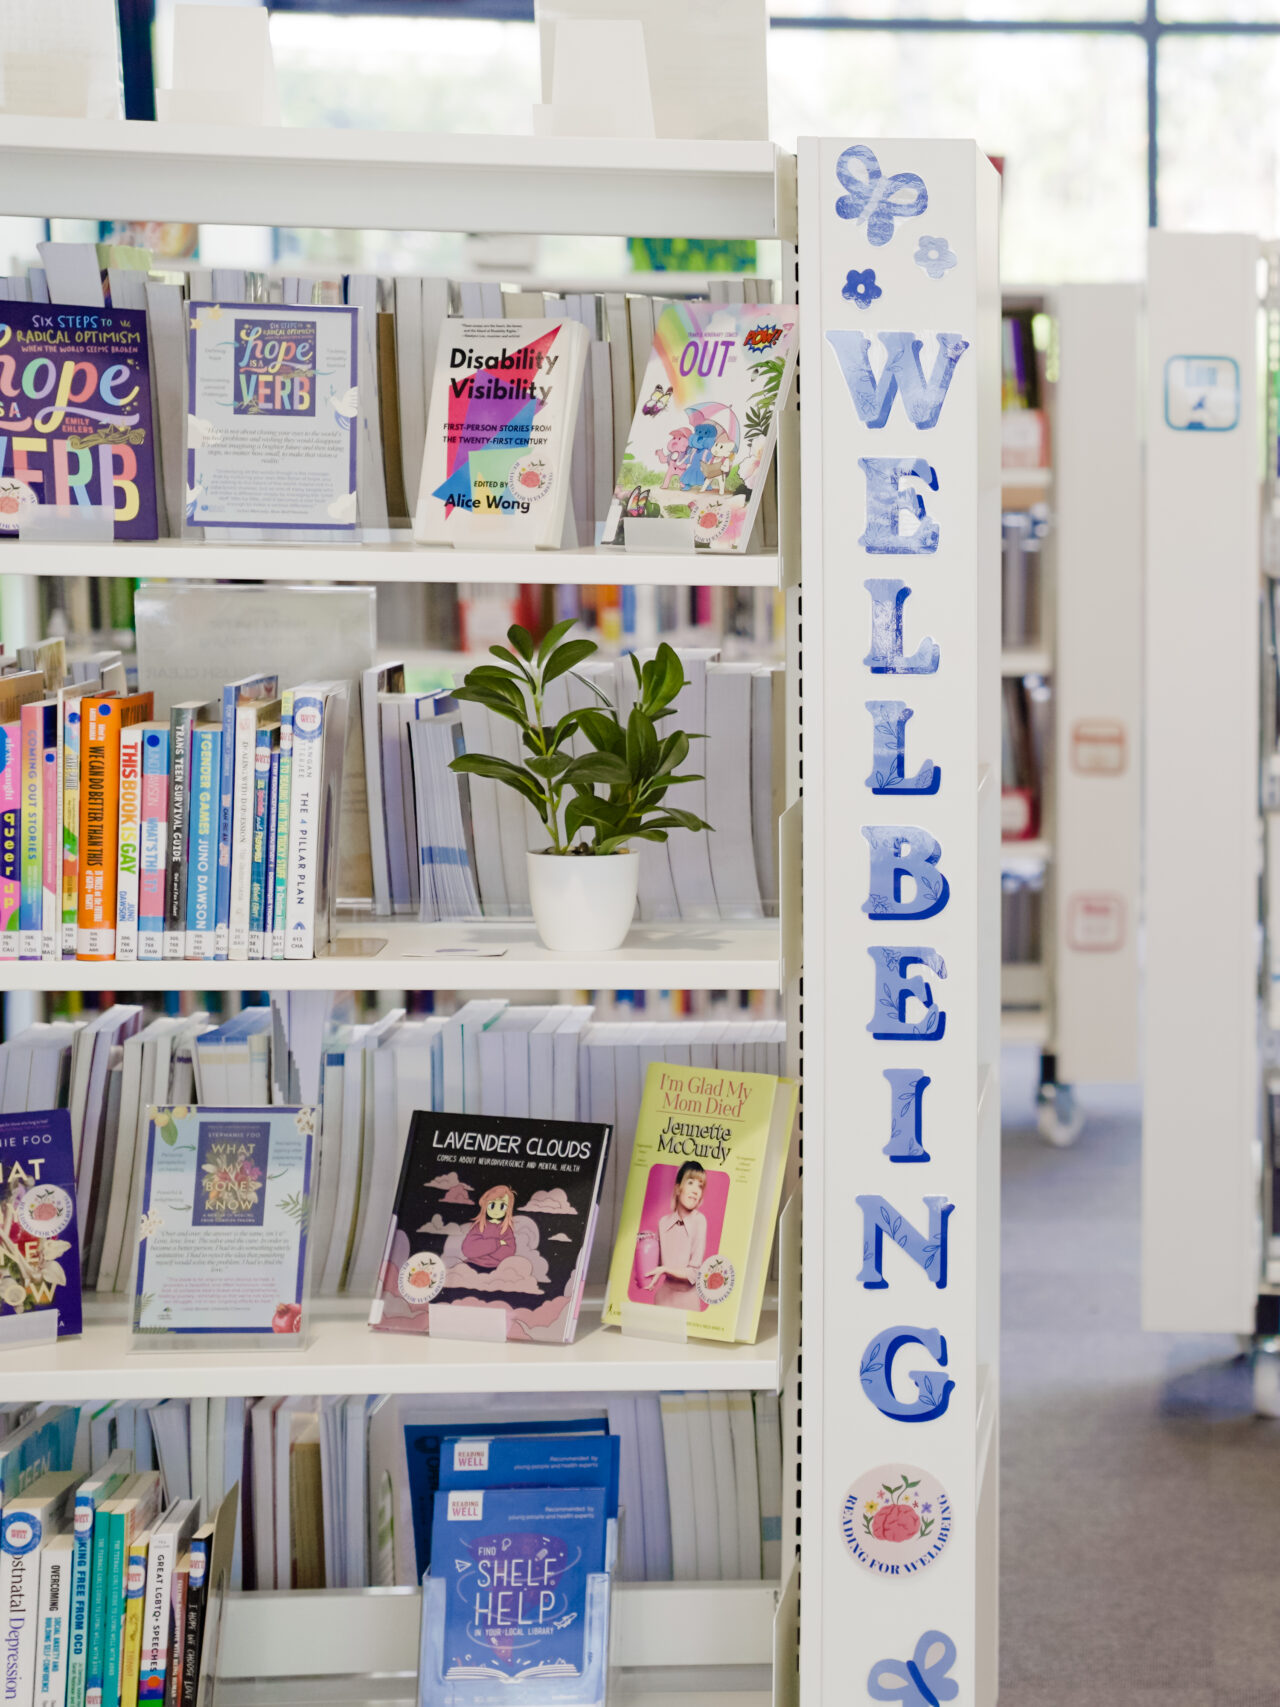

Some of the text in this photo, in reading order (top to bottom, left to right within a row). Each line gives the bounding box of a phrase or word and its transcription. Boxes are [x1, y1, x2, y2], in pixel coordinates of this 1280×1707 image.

[32, 315, 112, 329] SIX STEPS TO
[16, 330, 140, 344] RADICAL OPTIMISM
[45, 345, 57, 353] THE
[239, 327, 313, 374] hope
[743, 329, 783, 346] POW!
[450, 348, 559, 375] Disability
[679, 340, 735, 377] OUT
[239, 374, 311, 411] VERB
[450, 378, 553, 406] Visibility
[9, 402, 21, 418] A
[65, 417, 90, 425] EMILY
[443, 423, 497, 432] FIRST-PERSON
[499, 424, 530, 432] STORIES
[459, 437, 513, 445] TWENTY-FIRST
[473, 480, 509, 488] EDITED BY
[444, 493, 530, 514] Alice Wong
[27, 729, 38, 779] COMING
[88, 746, 105, 759] WE
[88, 760, 105, 777] CAN
[27, 783, 37, 807] OUT
[88, 777, 104, 790] DO
[172, 724, 185, 862] TRANS TEEN SURVIVAL GUIDE
[198, 741, 213, 835] GENDER GAMES
[87, 791, 104, 823] BETTER
[119, 742, 139, 875] THIS BOOK IS GAY
[300, 792, 309, 813] THE
[27, 811, 37, 860] STORIES
[87, 824, 104, 847] THAN
[3, 812, 16, 909] queer up
[87, 848, 104, 867] THIS
[297, 829, 308, 870] PILLAR
[196, 838, 209, 930] JUNO DAWSON
[296, 874, 306, 905] PLAN
[824, 330, 971, 1424] WELLBEING
[118, 890, 128, 922] DAWSON
[659, 1073, 753, 1106] I'm Glad My
[662, 1091, 743, 1118] Mom Died
[23, 1134, 52, 1145] FOO
[662, 1116, 732, 1142] Jennette
[211, 1143, 256, 1154] WHAT
[432, 1130, 592, 1159] LAVENDER CLOUDS
[656, 1134, 733, 1166] McCurdy
[0, 1159, 46, 1184] AT
[223, 1163, 245, 1172] MY
[436, 1154, 581, 1172] COMICS ABOUT NEURODIVERGENCE AND MENTAL HEALTH
[205, 1181, 256, 1192] BONES
[204, 1200, 254, 1211] KNOW
[458, 1457, 484, 1467] WELL
[452, 1507, 478, 1517] WELL
[842, 1494, 952, 1575] READING FOR WELLBEING
[478, 1546, 496, 1556] FIND
[155, 1554, 165, 1585] GREAT
[477, 1558, 557, 1588] SHELF
[48, 1564, 61, 1612] OVERCOMING
[75, 1570, 87, 1597] FREE
[74, 1600, 86, 1631] FROM
[152, 1587, 163, 1622] LGBTQ+
[475, 1590, 556, 1626] HELP
[4, 1554, 27, 1700] ostnatal Depression
[187, 1611, 198, 1631] HOPE
[474, 1627, 555, 1637] IN YOUR LOCAL LIBRARY
[51, 1617, 62, 1672] SOCIAL ANXIETY AND
[73, 1633, 84, 1656] OCD
[150, 1625, 160, 1672] SPEECHES
[187, 1634, 196, 1645] WE
[41, 1617, 53, 1693] BUILDING SELF-CONFIDENCE
[185, 1649, 196, 1676] CHOOSE
[184, 1680, 193, 1699] LOVE
